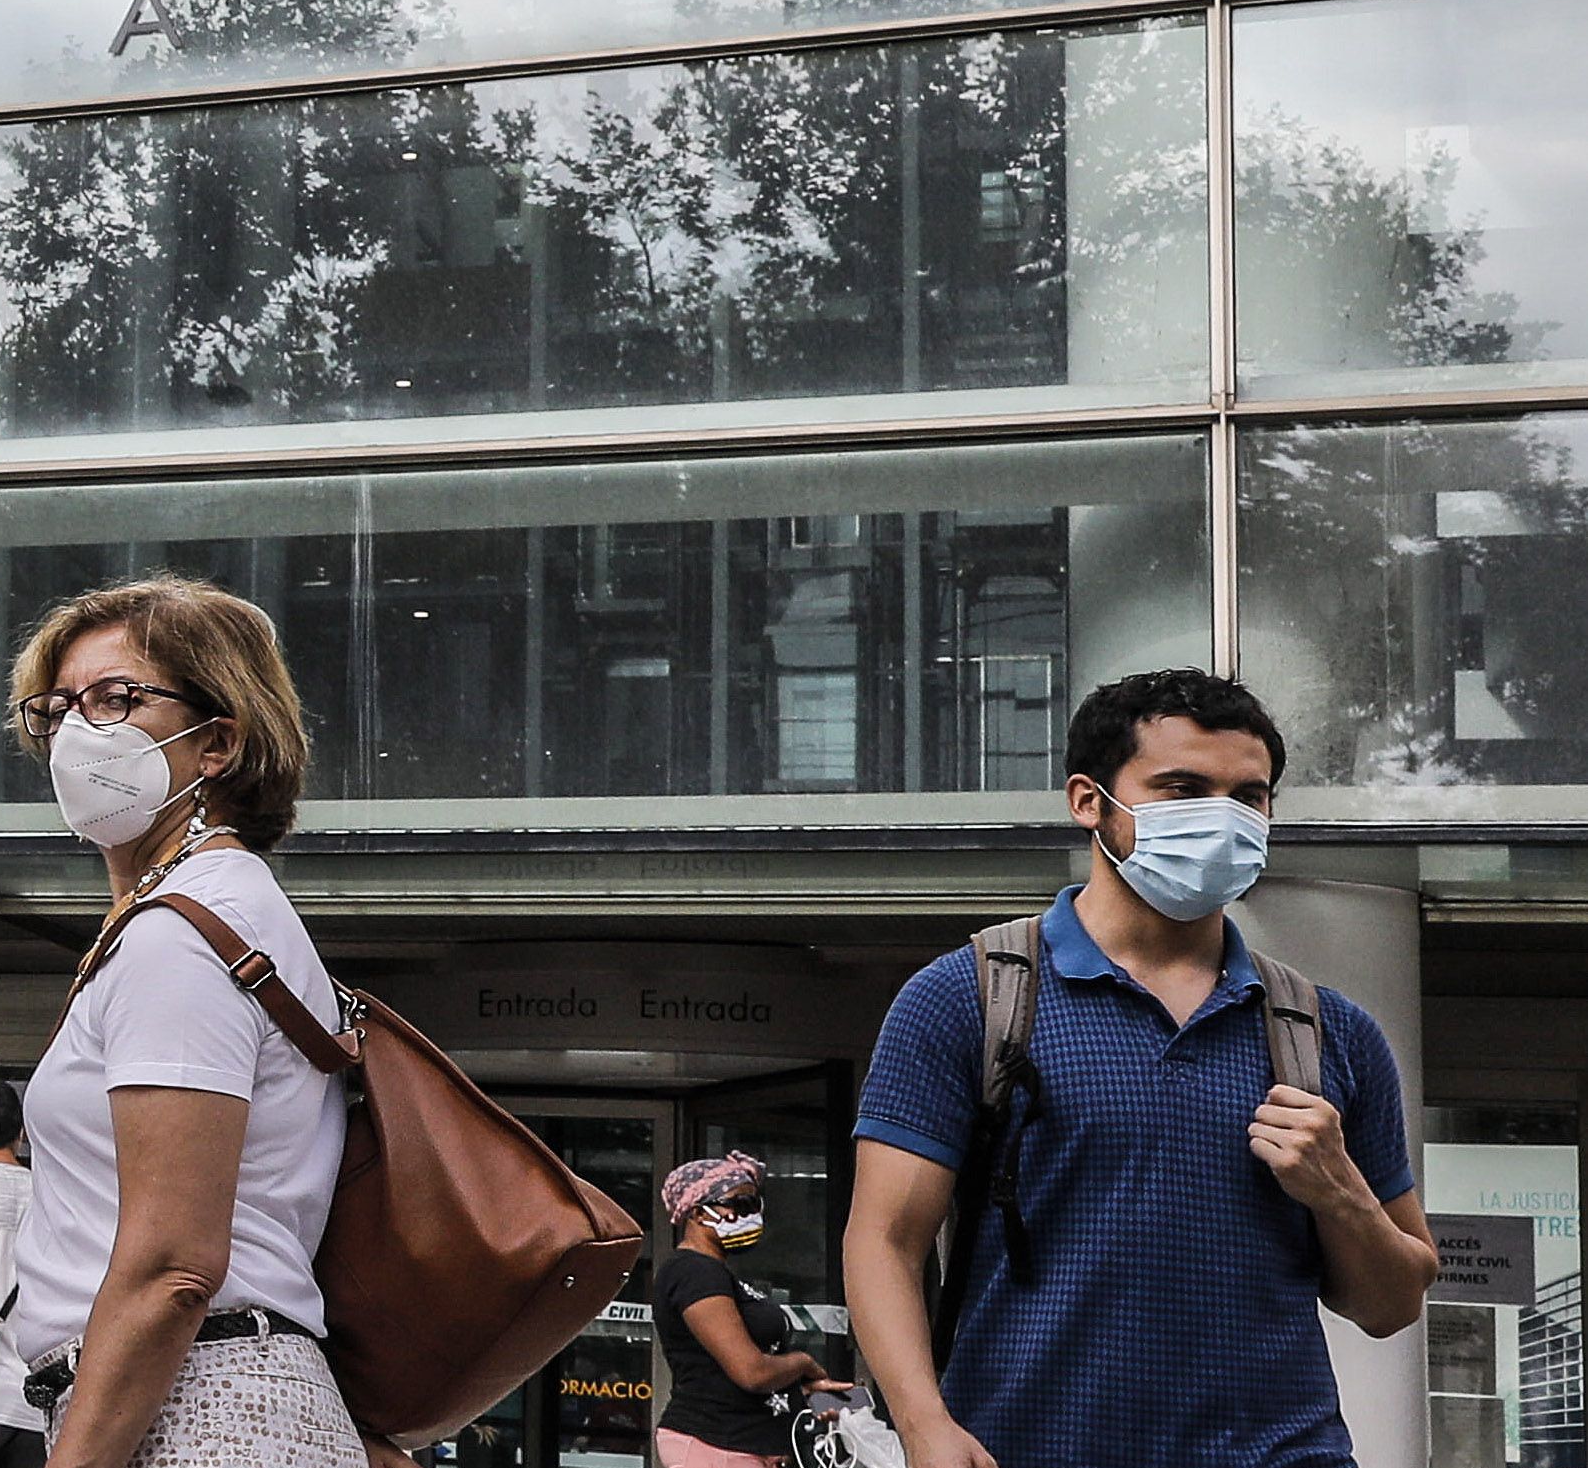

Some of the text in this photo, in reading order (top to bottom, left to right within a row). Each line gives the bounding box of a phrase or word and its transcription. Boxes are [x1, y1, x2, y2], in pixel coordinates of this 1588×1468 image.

[478, 987, 772, 1023] Entrada Entrada
[1480, 1192, 1579, 1210] LA JUSTICI
[1535, 1216, 1577, 1237] TRE
[1439, 1255, 1513, 1269] STRE CIVIL
[1437, 1272, 1490, 1284] FIRMES
[608, 1305, 645, 1319] CIVIL
